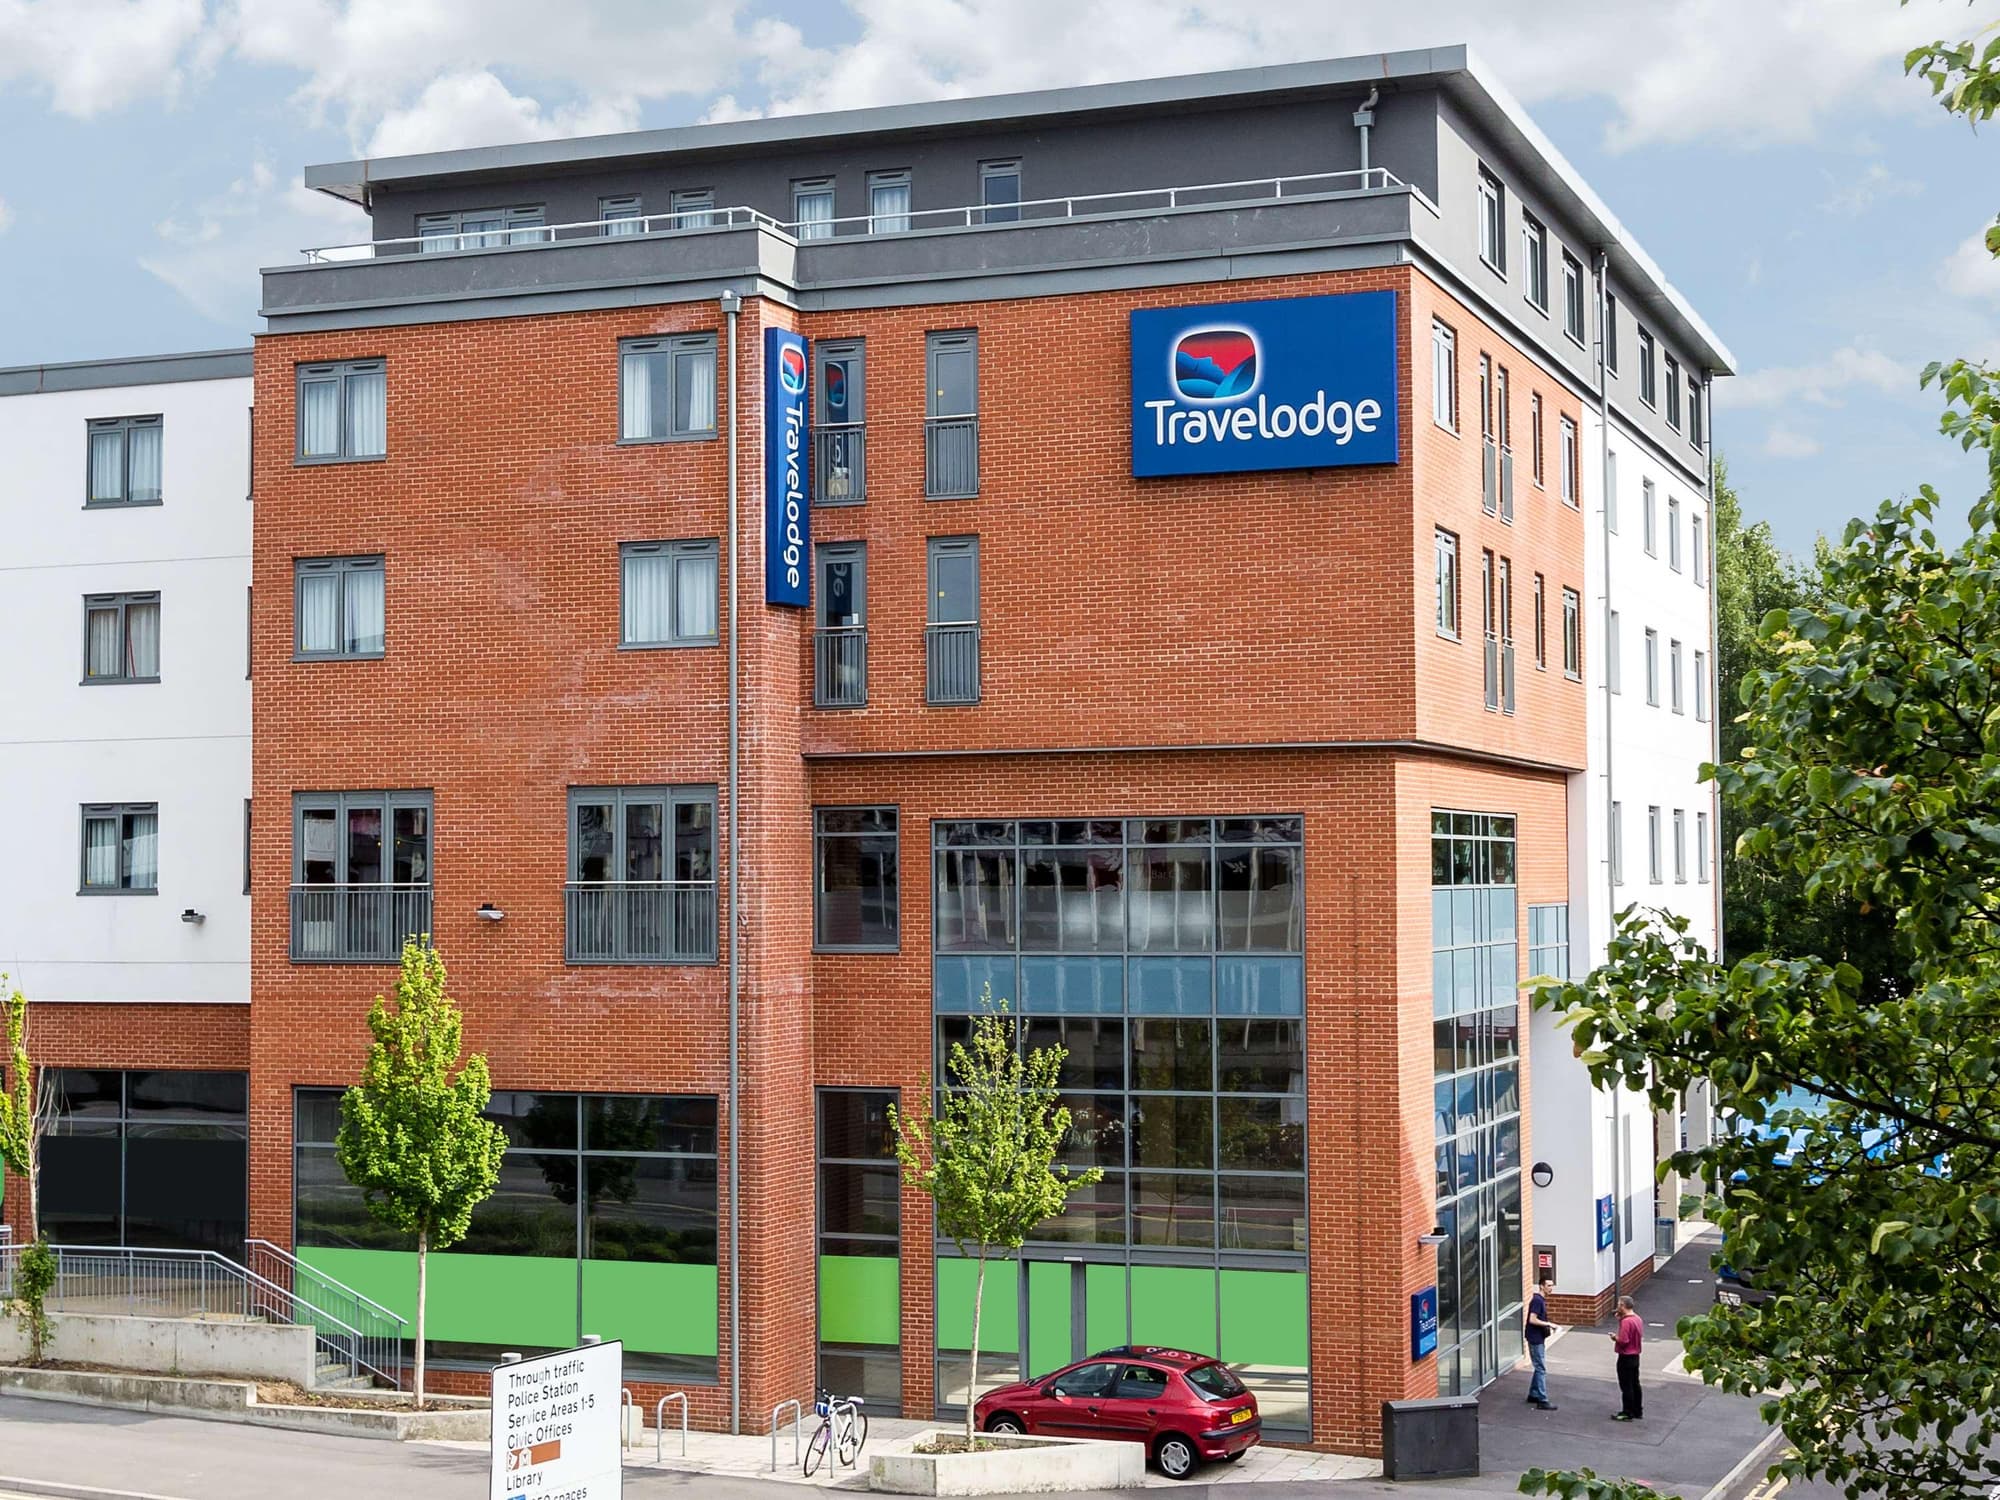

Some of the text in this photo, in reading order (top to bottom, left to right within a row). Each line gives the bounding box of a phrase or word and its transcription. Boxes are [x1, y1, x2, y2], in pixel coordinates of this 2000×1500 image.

[1144, 390, 1382, 446] Travelodge
[783, 400, 804, 589] Travelodge
[509, 1359, 585, 1389] Through traffic
[508, 1381, 579, 1409] Police Station
[508, 1393, 595, 1429] Service Areas 1-5
[507, 1423, 572, 1449] Civic Offices
[506, 1472, 542, 1490] Library
